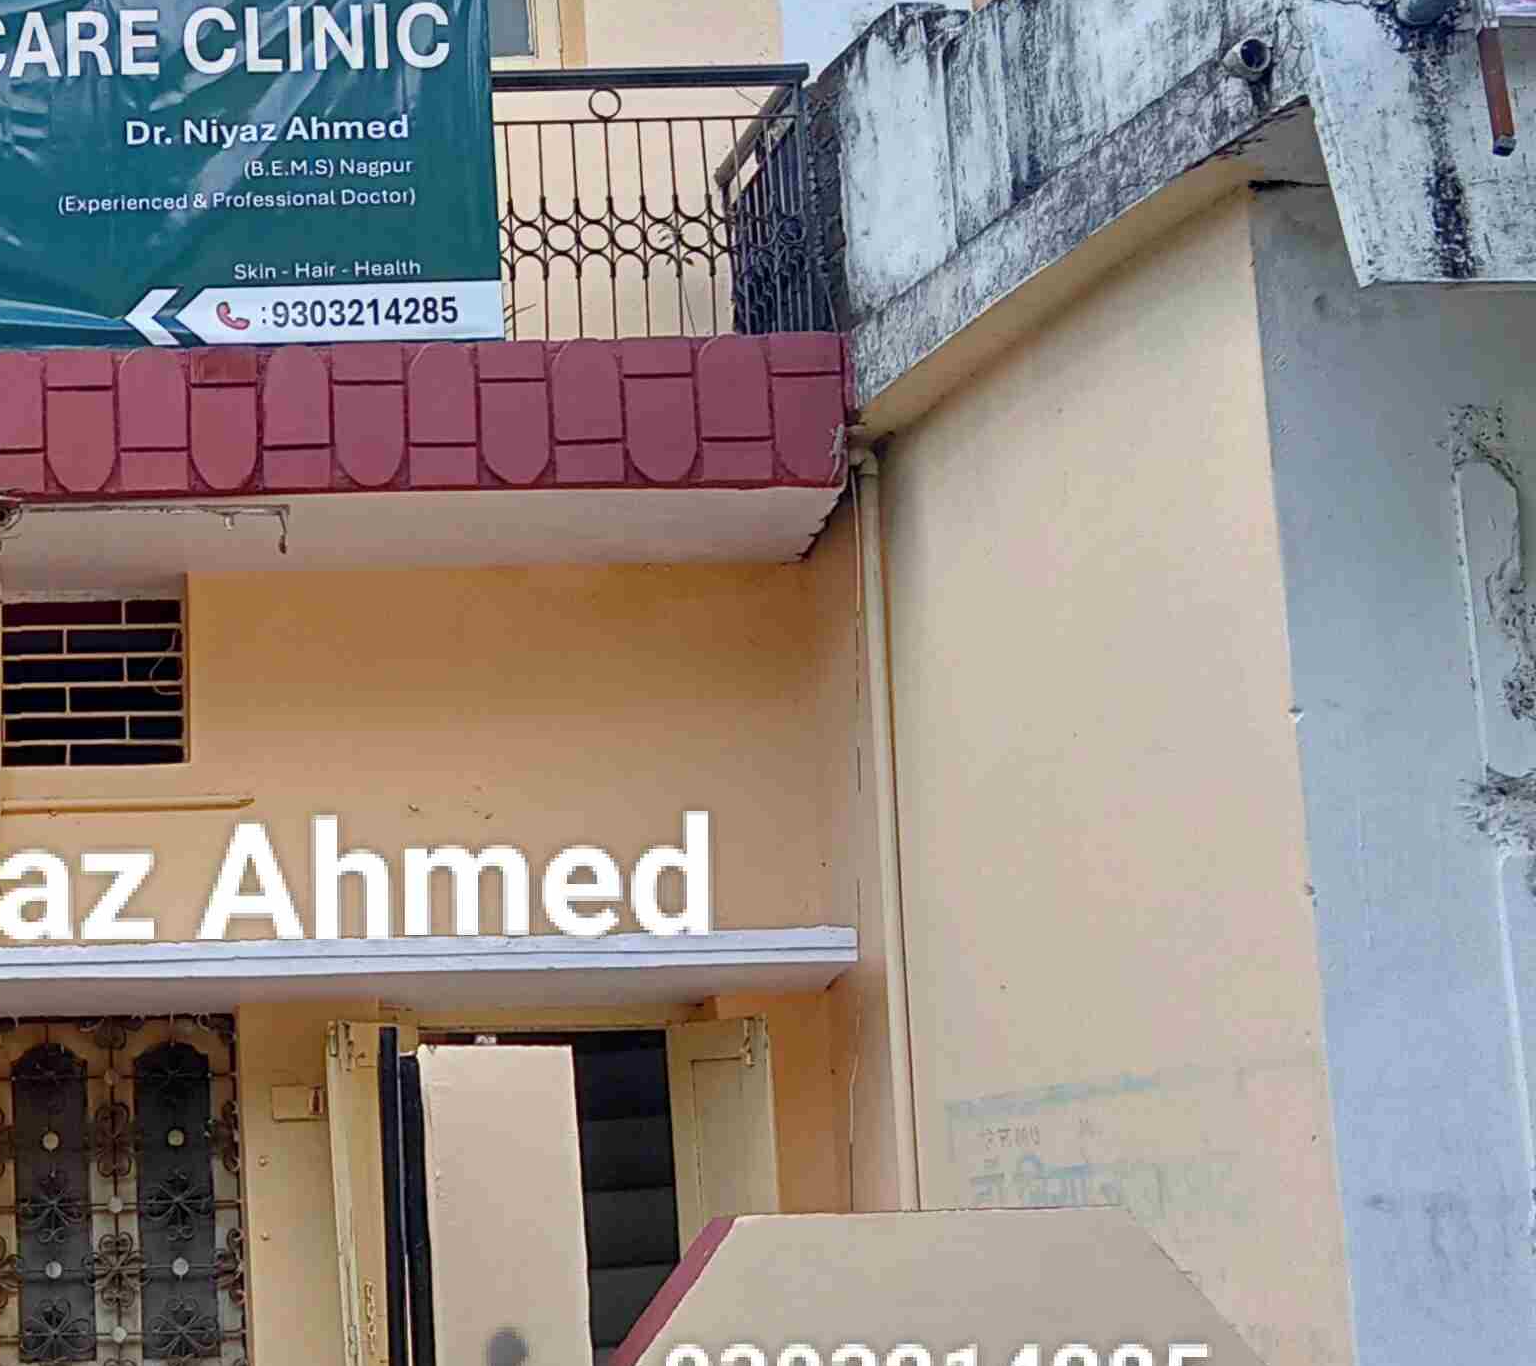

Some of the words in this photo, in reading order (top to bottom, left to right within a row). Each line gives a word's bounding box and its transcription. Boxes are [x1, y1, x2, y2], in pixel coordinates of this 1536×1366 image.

[183, 2, 450, 75] CLINIC
[125, 120, 173, 146] Dr.
[183, 118, 278, 149] Niyaz
[286, 114, 410, 141] Ahmed
[243, 160, 334, 180] (B.E.M.S)
[340, 158, 413, 178] Nagpur
[58, 194, 188, 215] (Experienced
[193, 192, 208, 209] &
[213, 189, 336, 209] Professional
[341, 187, 416, 206] Doctor)
[234, 263, 276, 280] Skin
[295, 262, 335, 278] Hair
[354, 260, 421, 277] Health
